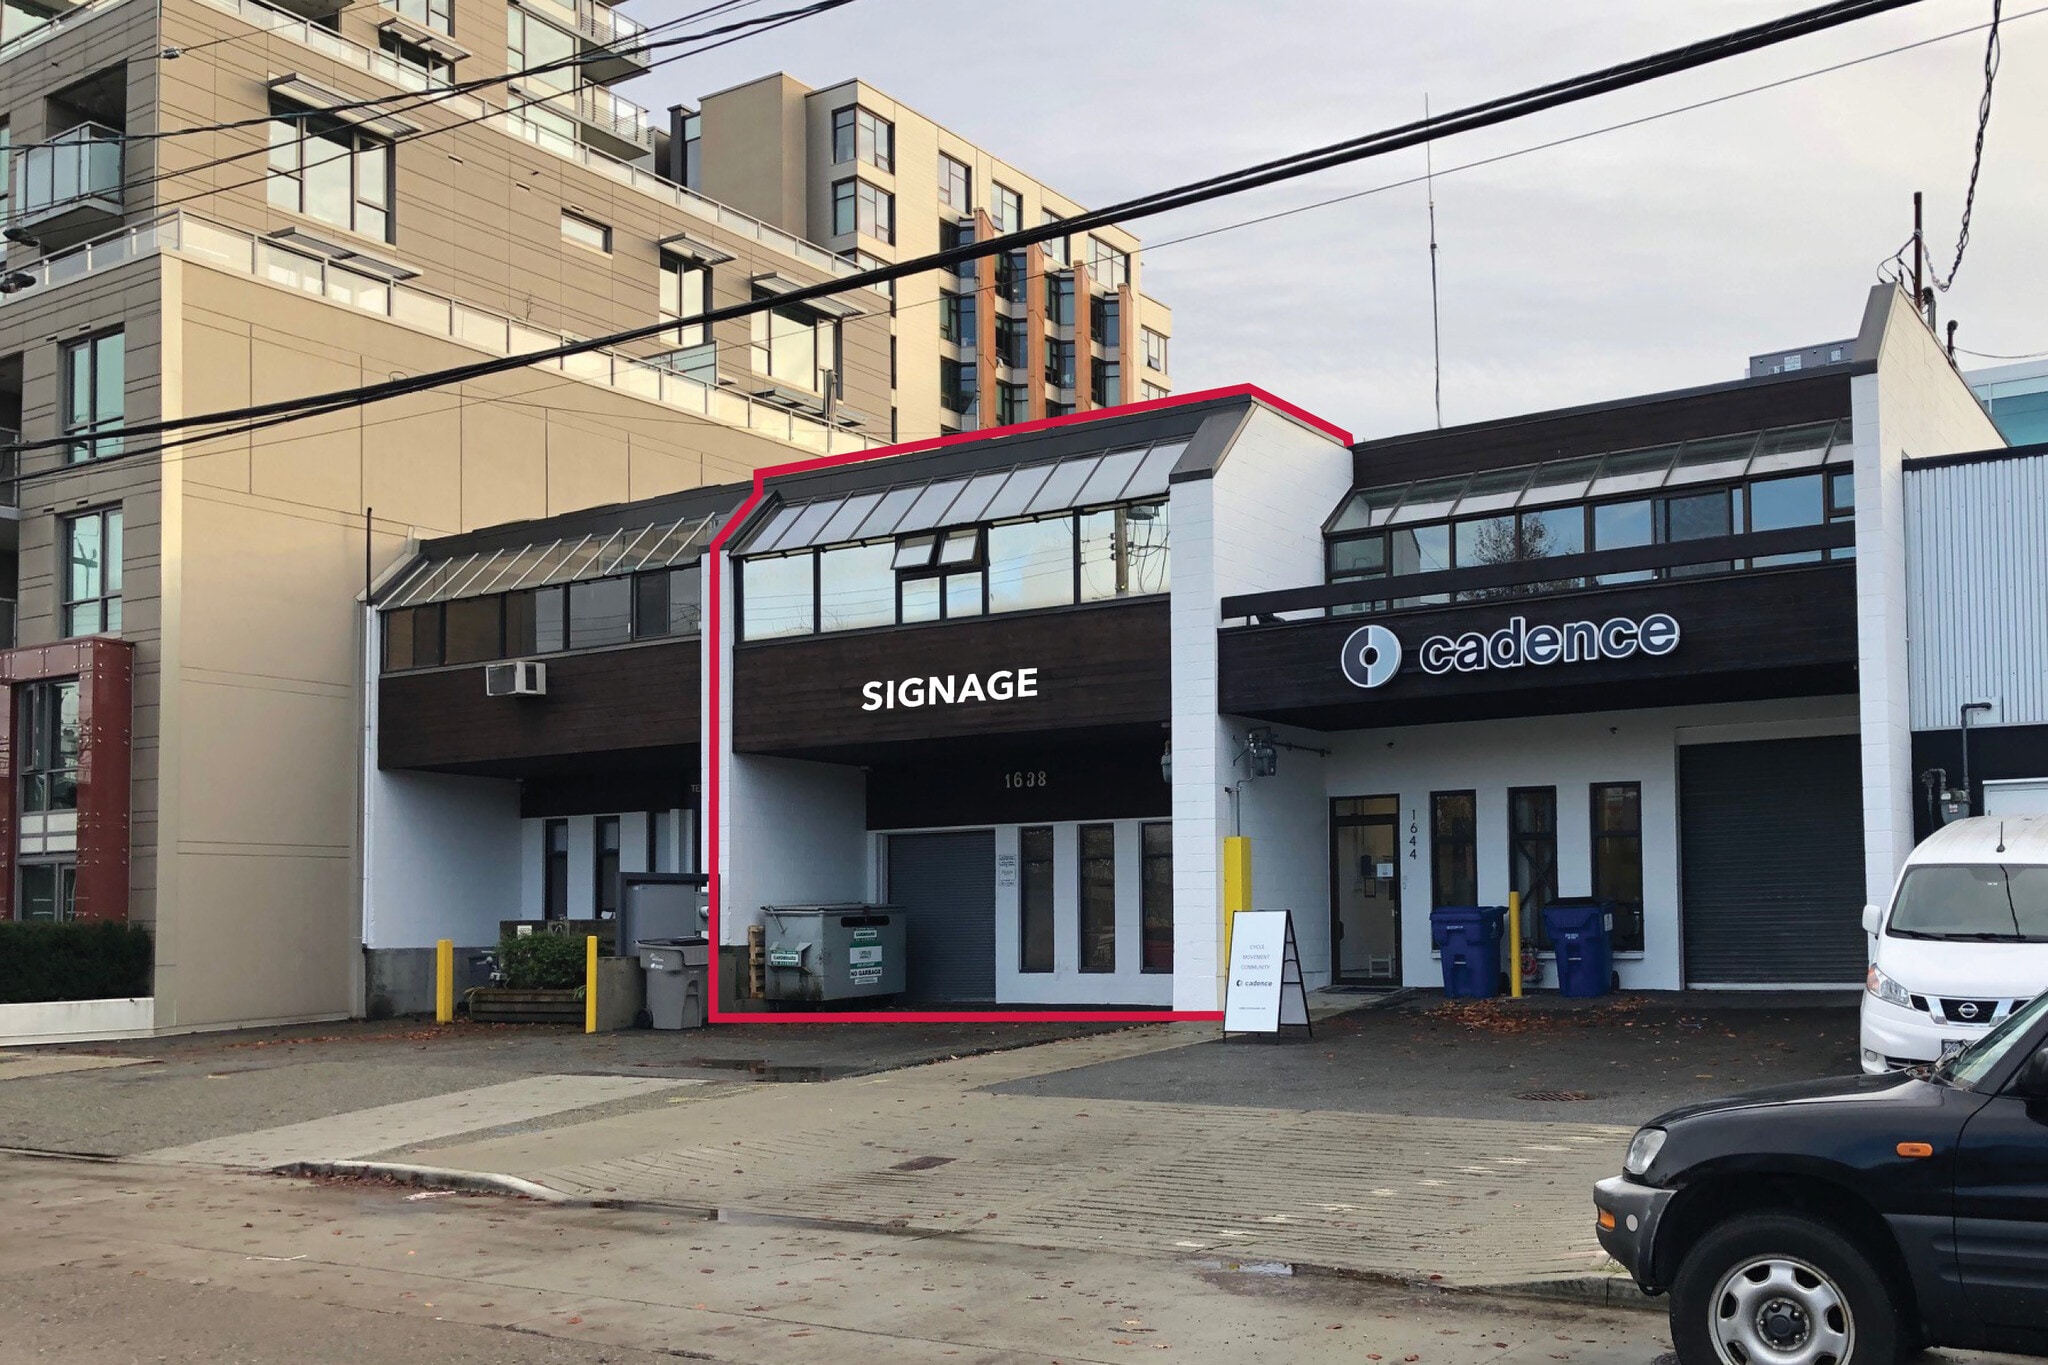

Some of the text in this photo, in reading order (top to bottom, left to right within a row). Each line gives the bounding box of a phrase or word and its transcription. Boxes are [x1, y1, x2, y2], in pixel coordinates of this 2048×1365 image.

[1420, 613, 1681, 675] cadence
[1005, 771, 1047, 788] 1638
[1409, 809, 1418, 860] 1644
